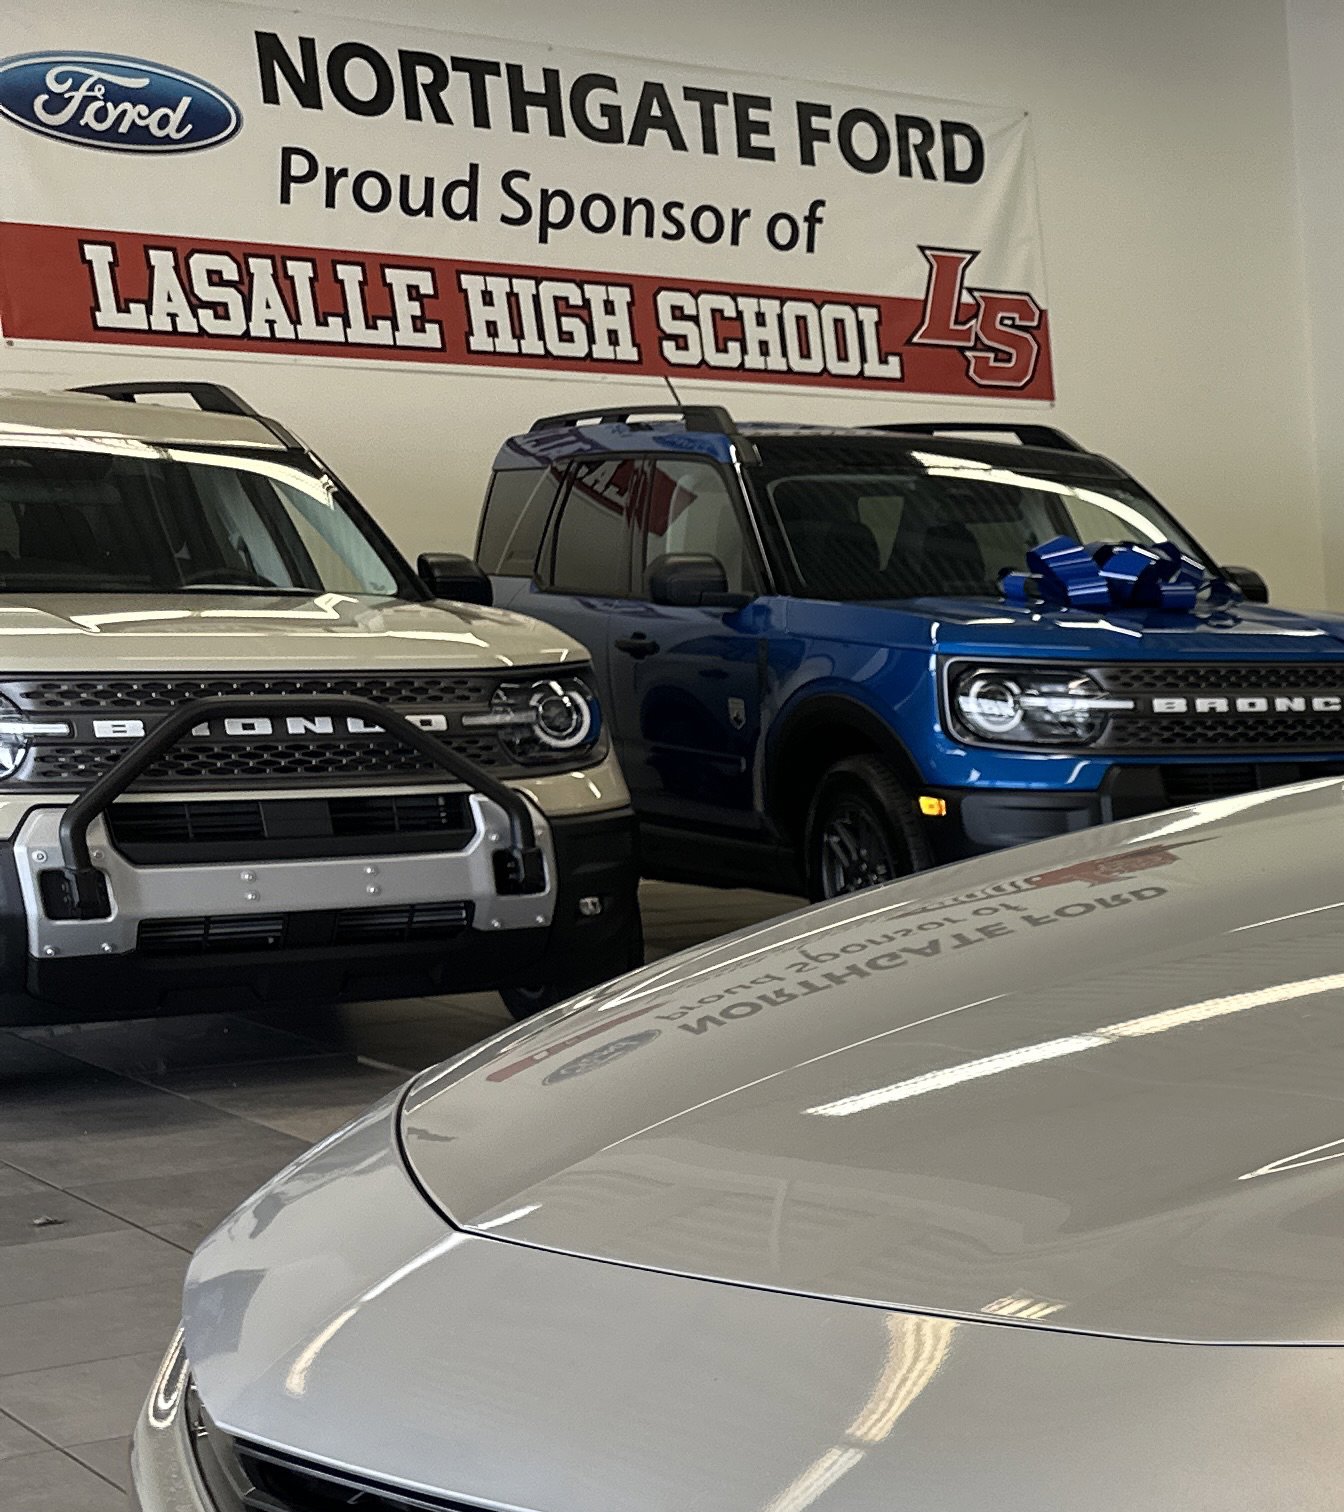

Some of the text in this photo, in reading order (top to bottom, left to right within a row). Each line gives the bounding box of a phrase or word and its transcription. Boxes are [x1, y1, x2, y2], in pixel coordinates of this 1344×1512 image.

[33, 65, 192, 142] Ford
[253, 30, 985, 185] NORTHGATE FORD
[278, 145, 825, 254] Proud Sponsor of
[80, 241, 903, 380] LASALLE HIGH SCHOOL
[908, 243, 1045, 390] LS
